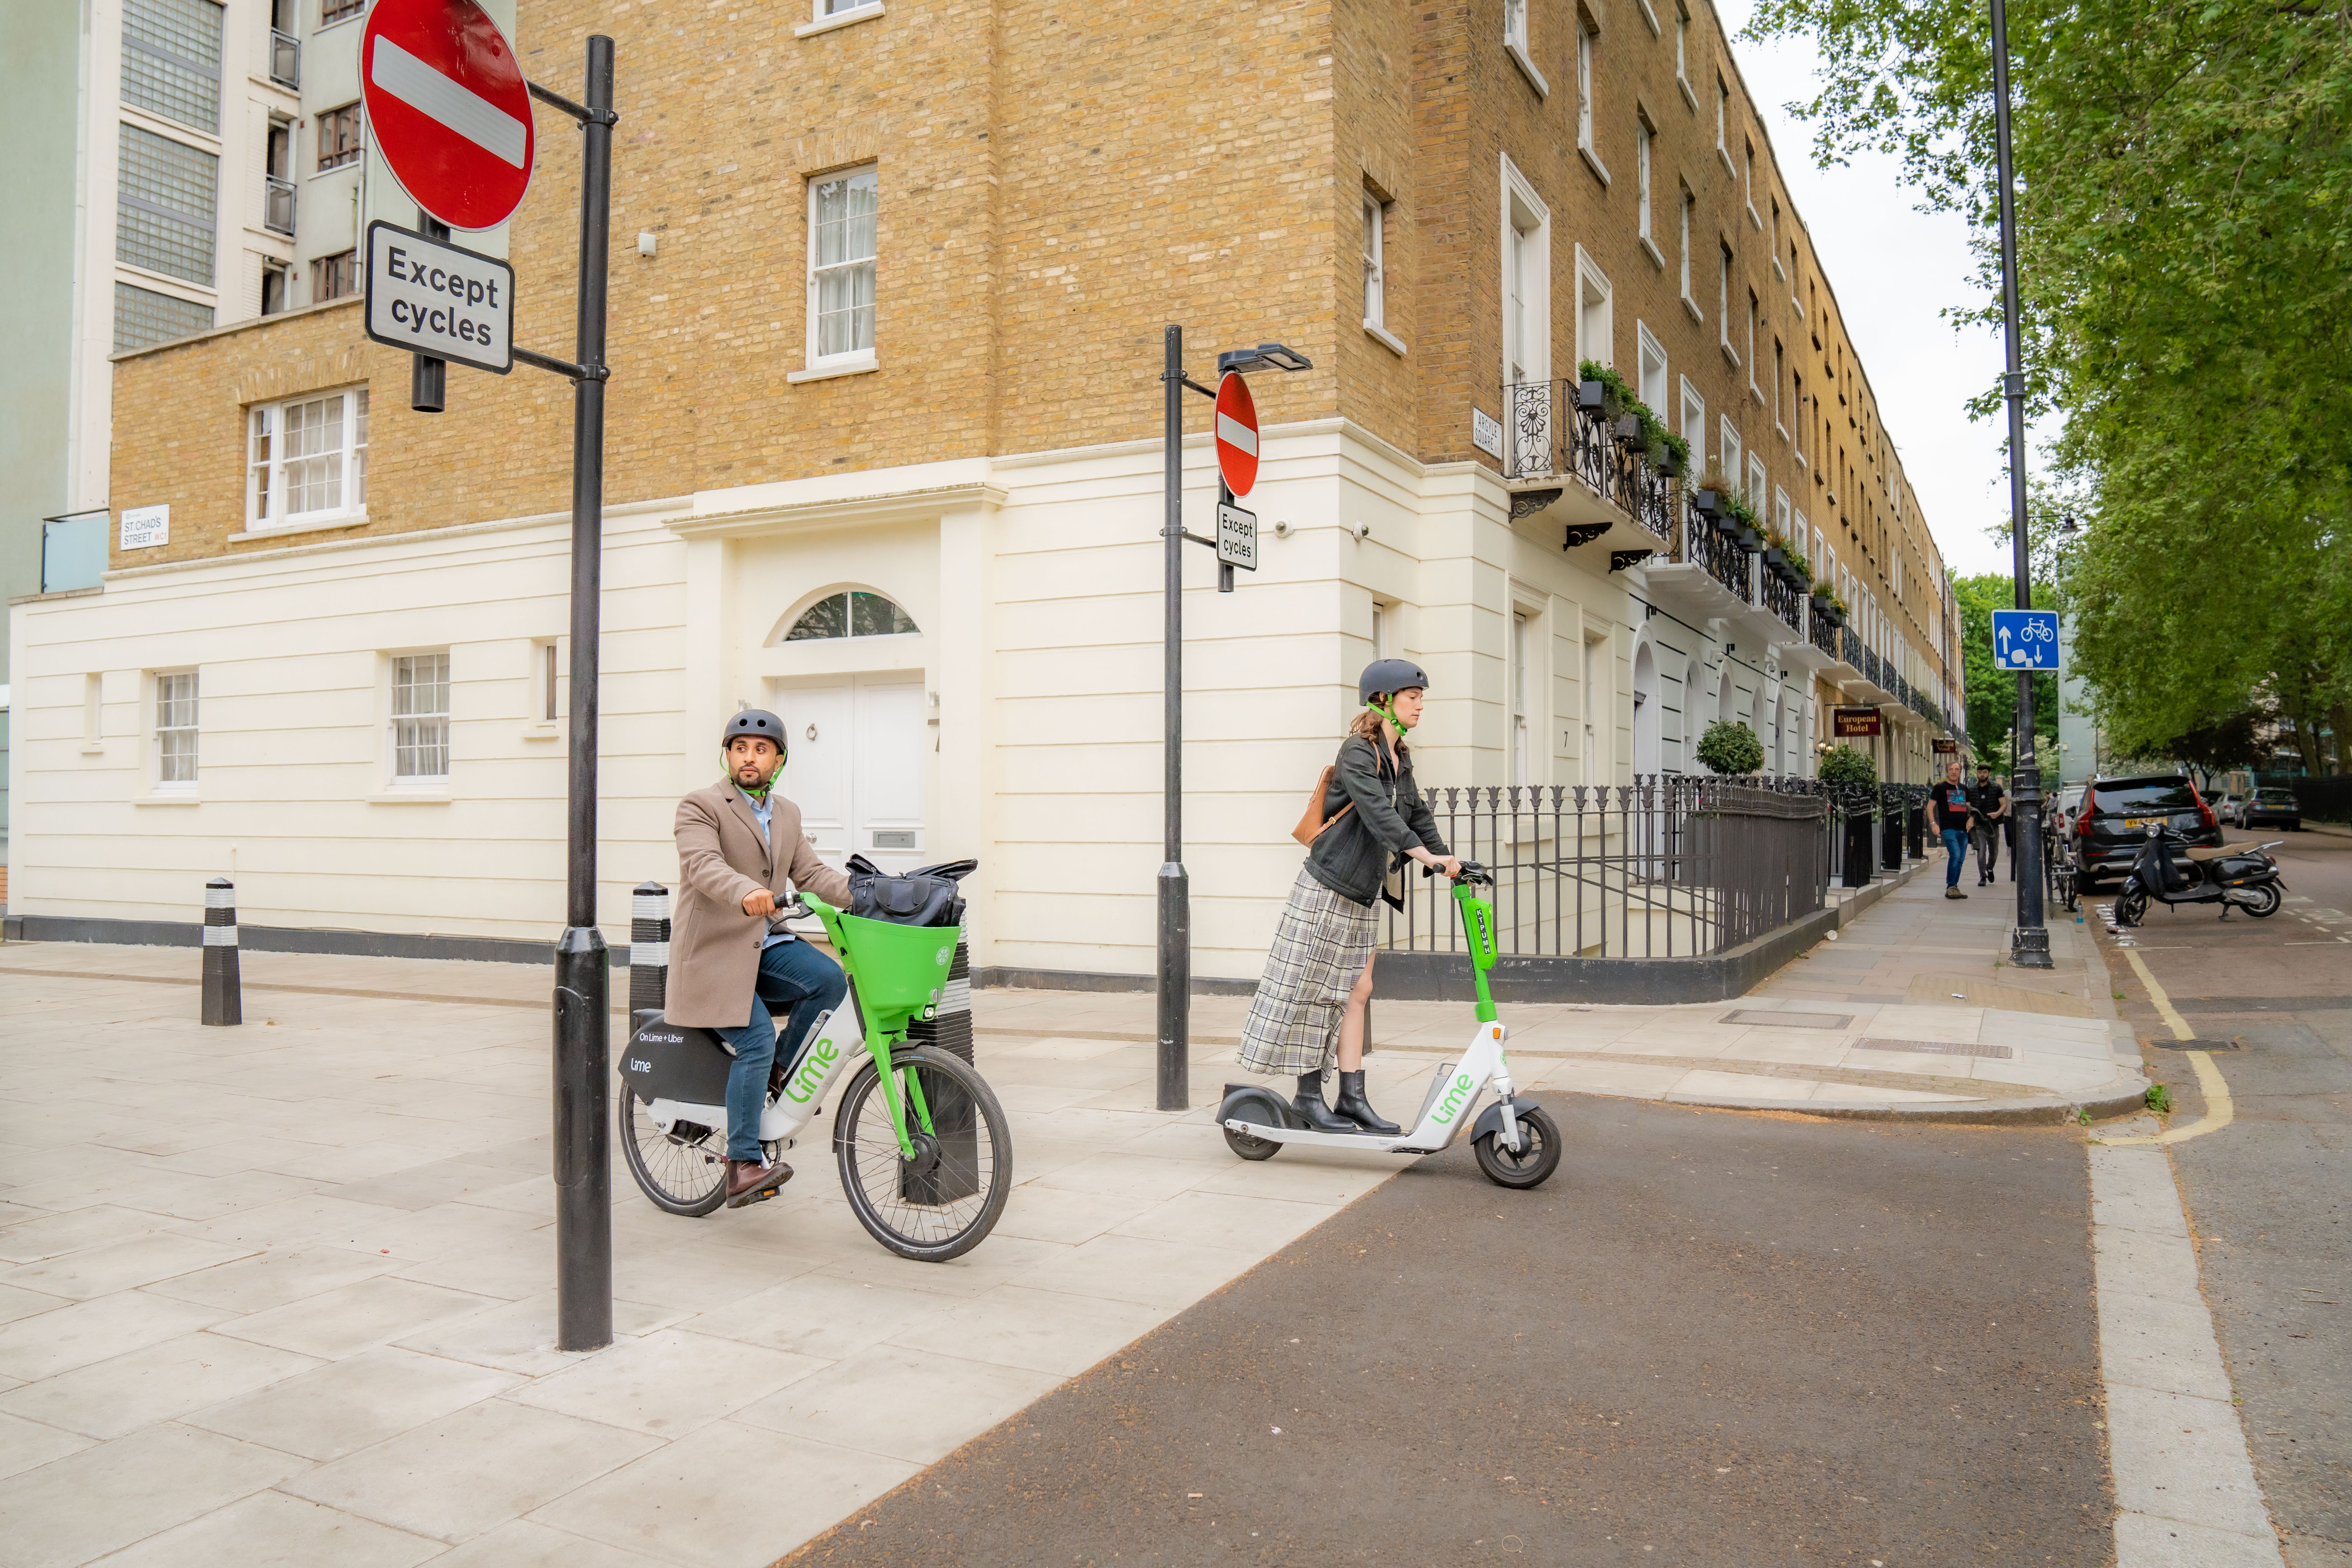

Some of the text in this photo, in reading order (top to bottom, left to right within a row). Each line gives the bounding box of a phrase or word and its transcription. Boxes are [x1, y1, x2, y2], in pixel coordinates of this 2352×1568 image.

[388, 245, 498, 309] Except
[392, 299, 491, 346] cycles
[1478, 414, 1497, 438] ARGYLE
[1475, 428, 1493, 451] SQUARE
[1223, 513, 1252, 538] Except
[124, 532, 152, 545] STREET
[1224, 539, 1251, 558] cycles
[1838, 715, 1876, 724] European
[1564, 731, 1568, 748] 7
[1477, 910, 1490, 953] KTPUMH
[640, 1033, 648, 1041] On
[649, 1033, 662, 1042] Lime
[668, 1034, 684, 1043] Uber
[631, 1058, 651, 1073] Lime
[785, 1038, 839, 1103] Lime
[1431, 1074, 1473, 1124] Lime
